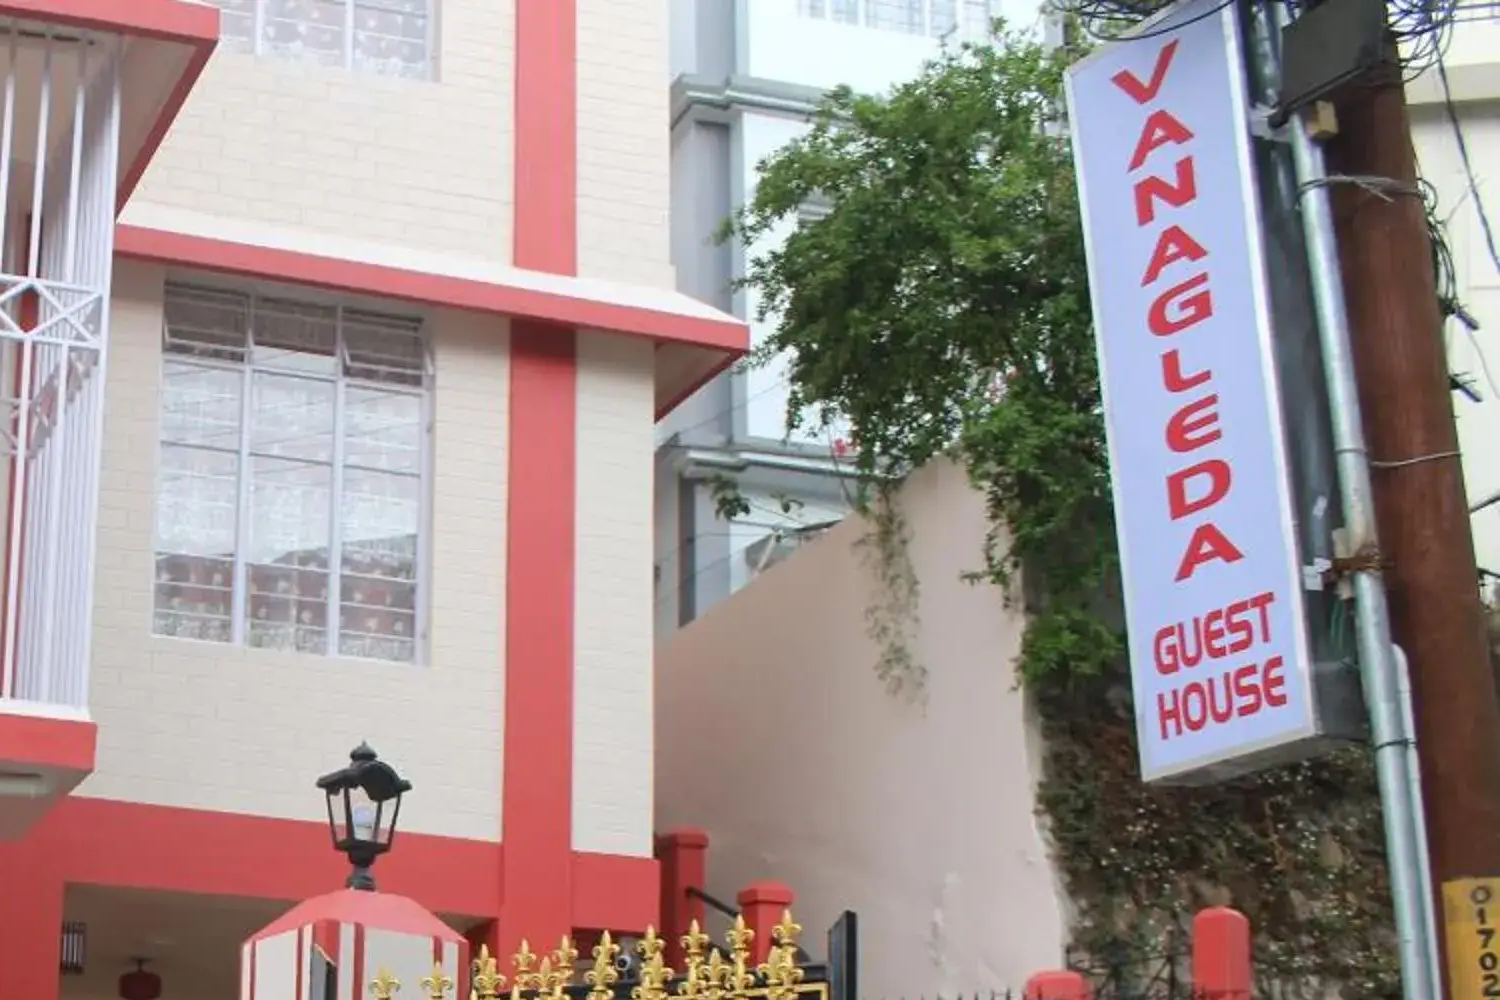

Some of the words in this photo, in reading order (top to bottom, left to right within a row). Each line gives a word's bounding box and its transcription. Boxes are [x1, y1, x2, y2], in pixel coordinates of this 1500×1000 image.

[1110, 38, 1244, 582] VANAGLEDA
[1153, 591, 1275, 675] GUEST
[1157, 655, 1288, 739] HOUSE
